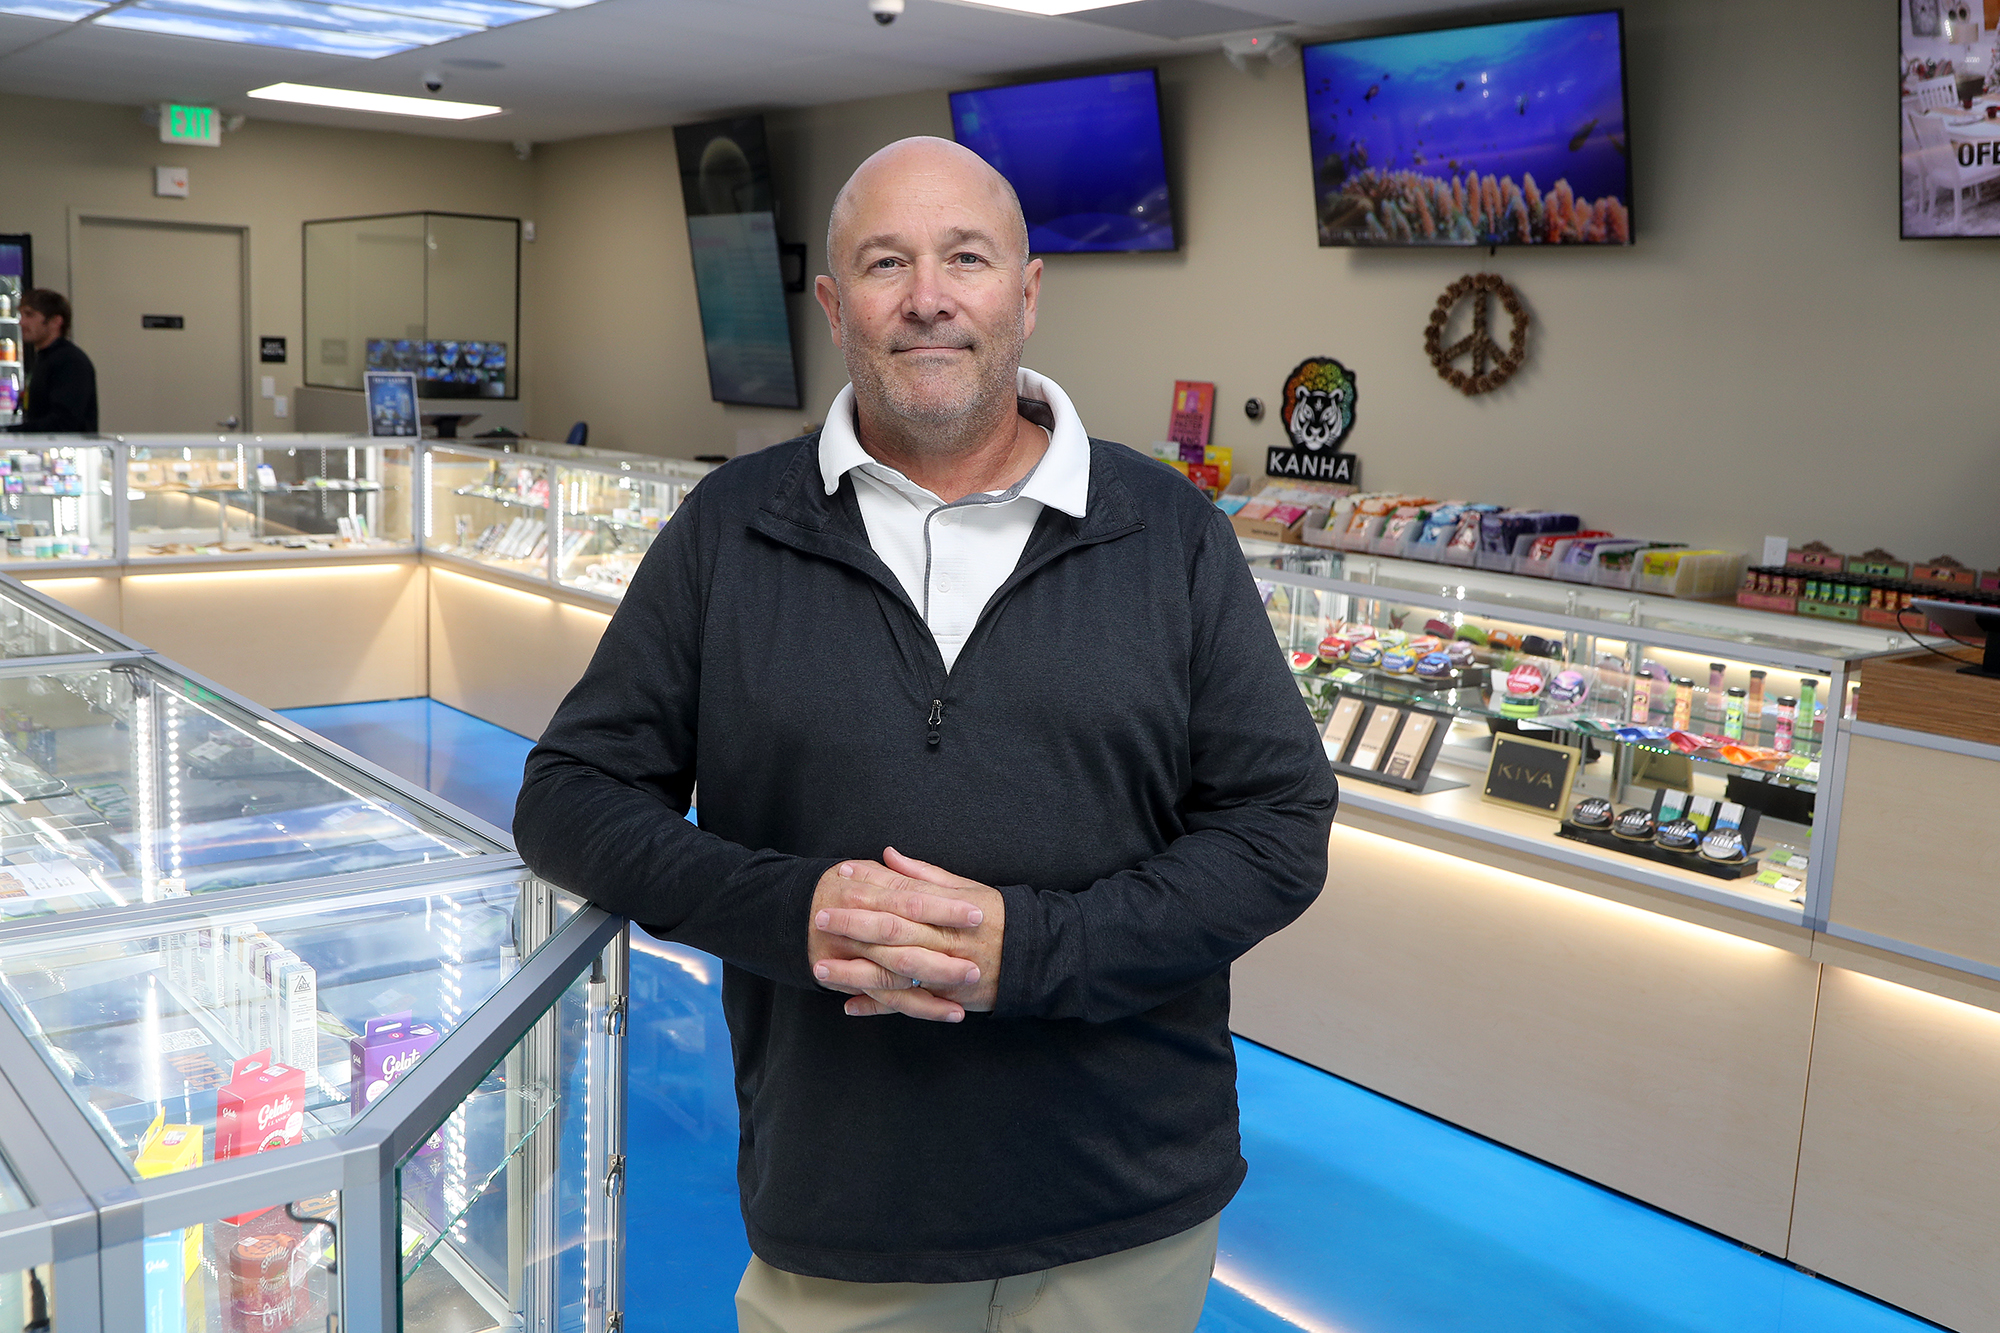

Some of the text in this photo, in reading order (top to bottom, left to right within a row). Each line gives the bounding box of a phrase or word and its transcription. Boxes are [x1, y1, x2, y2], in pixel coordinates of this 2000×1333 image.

[170, 104, 213, 140] EXIT
[1269, 451, 1349, 480] KANHA
[1498, 762, 1554, 790] KIVA
[382, 1048, 421, 1082] Gelat
[257, 1094, 294, 1131] Gelato
